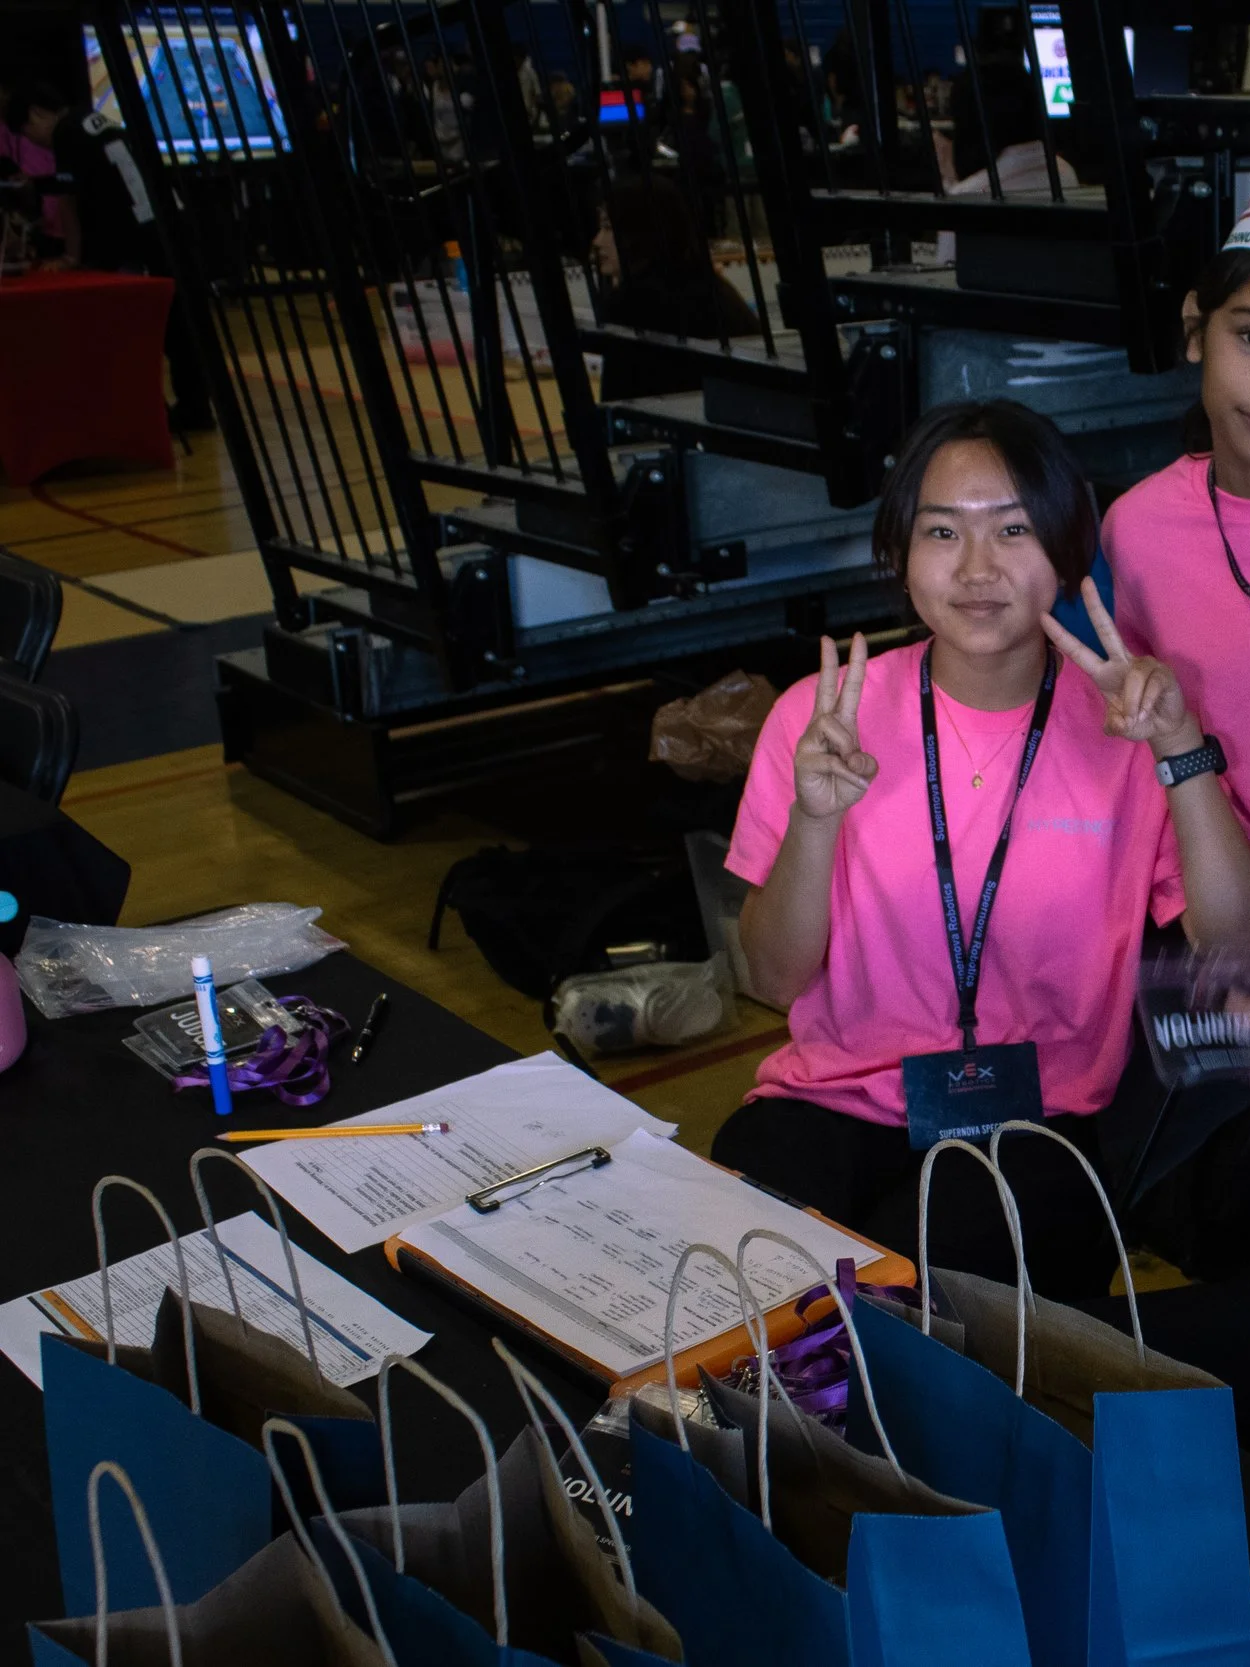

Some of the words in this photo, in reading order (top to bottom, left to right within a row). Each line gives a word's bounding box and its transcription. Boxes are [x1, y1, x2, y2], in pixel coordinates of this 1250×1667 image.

[926, 733, 939, 782] Robotics
[1018, 729, 1043, 786] Supernova
[930, 783, 947, 842] Supernova
[943, 883, 959, 932] Robotics
[973, 880, 998, 940] Supernova
[950, 932, 966, 992] ernova
[966, 941, 983, 988] Robotics
[947, 1062, 995, 1082] VEX
[938, 1126, 981, 1141] SUPERNOVA
